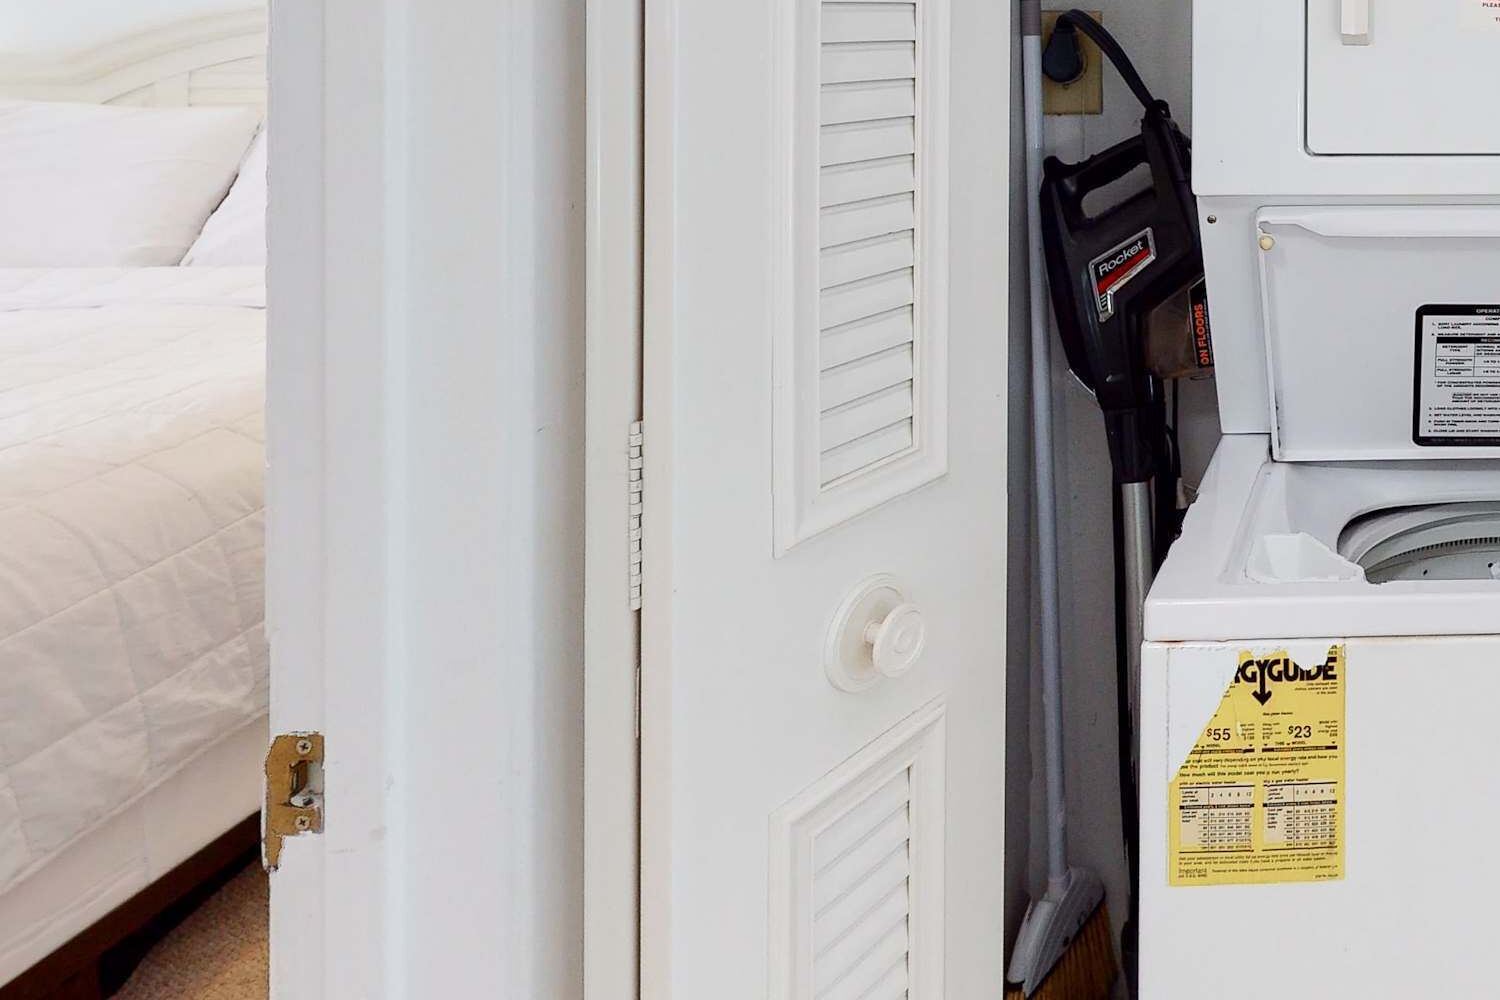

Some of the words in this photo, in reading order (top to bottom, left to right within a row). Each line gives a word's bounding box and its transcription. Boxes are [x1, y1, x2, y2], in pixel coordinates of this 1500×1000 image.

[1098, 240, 1144, 277] Rocket
[1194, 304, 1207, 347] FLOORS
[1200, 349, 1209, 364] ON
[1206, 728, 1231, 741] $55
[1288, 725, 1312, 738] $23
